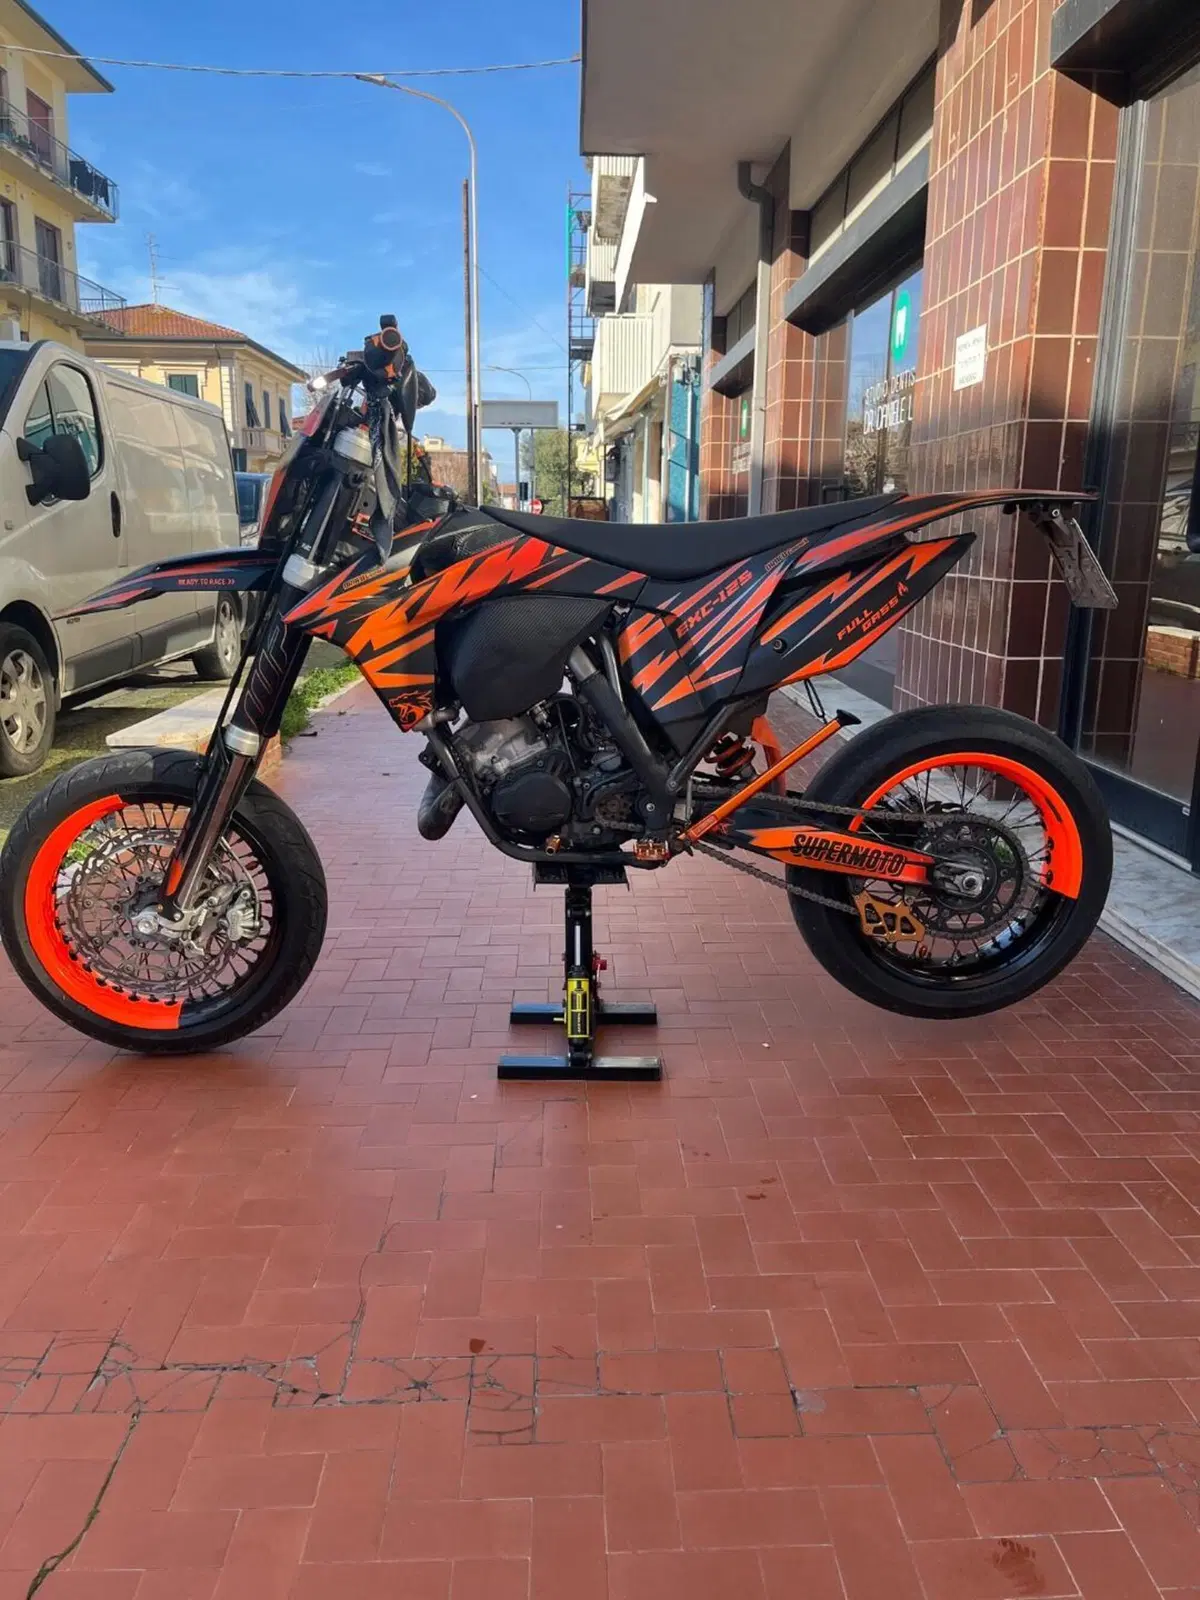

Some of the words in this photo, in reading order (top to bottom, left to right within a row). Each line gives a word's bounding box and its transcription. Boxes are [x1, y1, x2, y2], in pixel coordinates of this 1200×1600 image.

[178, 578, 199, 586] READY
[200, 578, 209, 586] TO
[209, 578, 226, 586] RACE
[676, 569, 753, 639] EXC-125
[836, 608, 873, 641] FULL
[789, 833, 907, 876] SUPERMOTO
